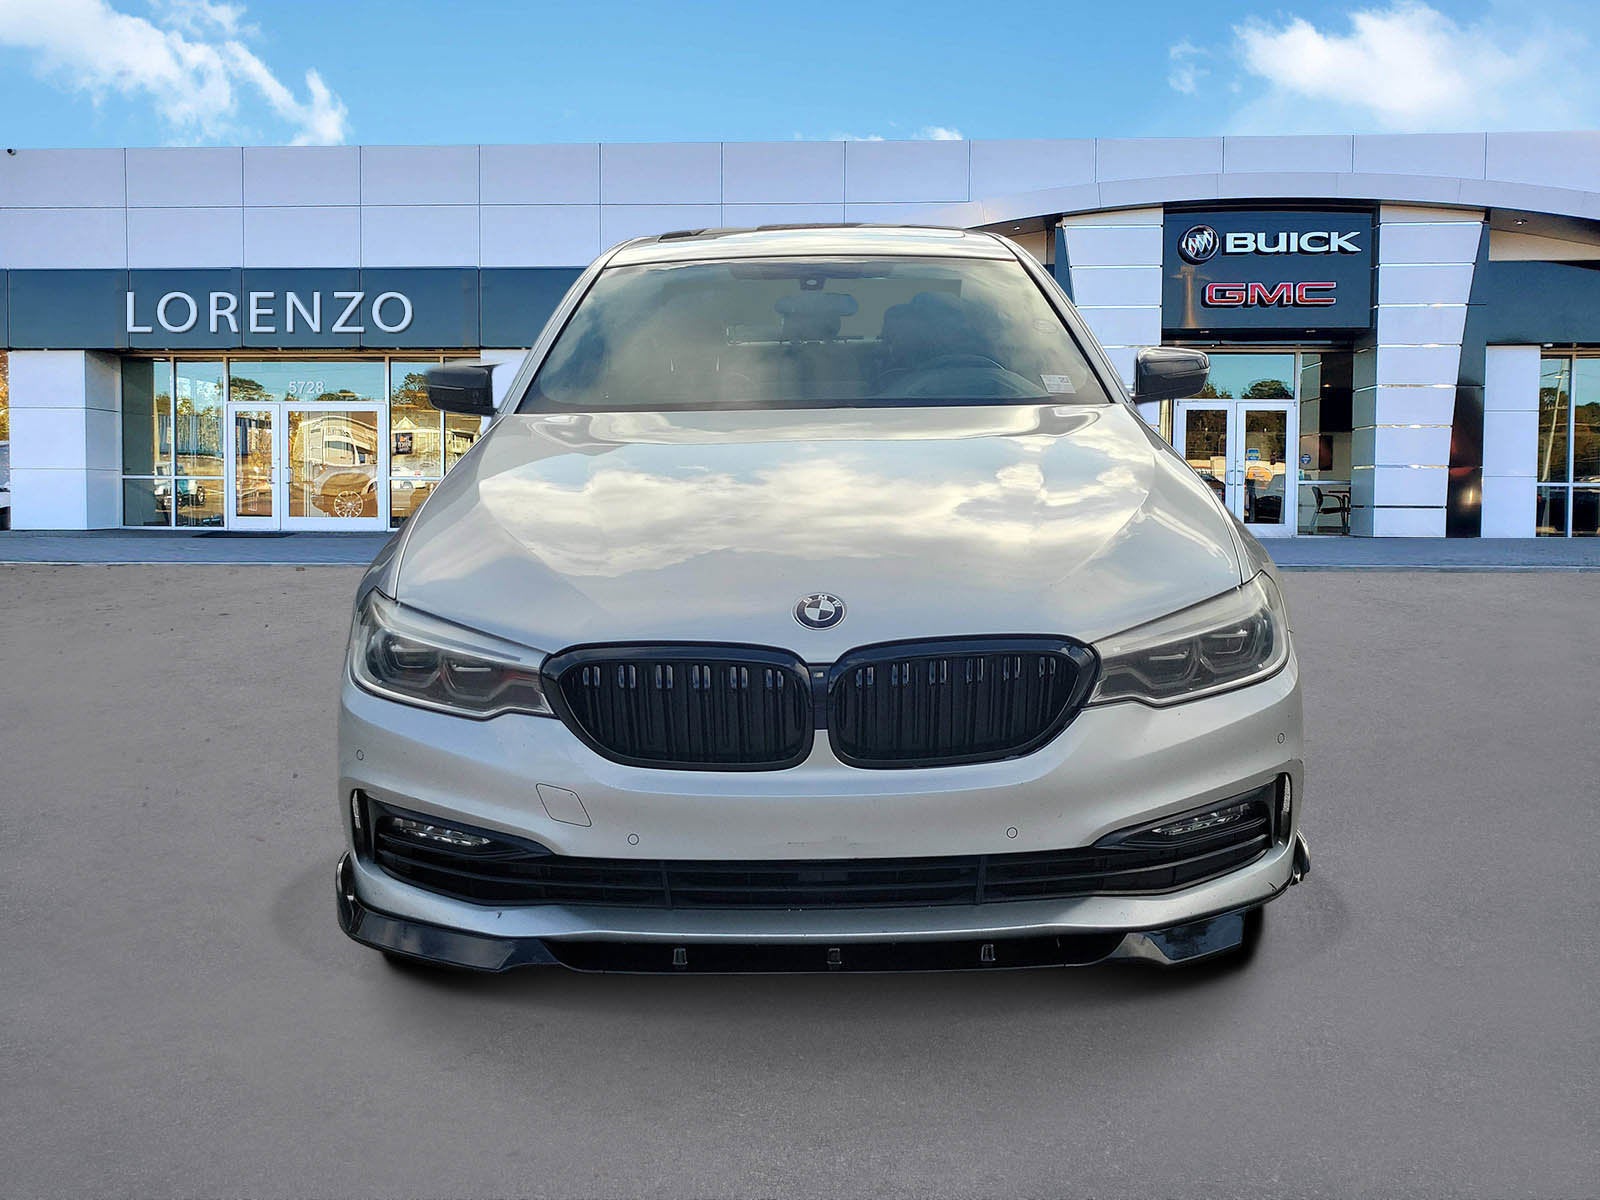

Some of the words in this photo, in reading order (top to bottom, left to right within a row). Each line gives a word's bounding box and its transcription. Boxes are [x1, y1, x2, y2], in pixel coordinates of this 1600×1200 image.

[1226, 231, 1362, 253] BUICK
[1207, 281, 1337, 305] GMC
[126, 291, 413, 333] LORENZO
[288, 380, 325, 395] 5728
